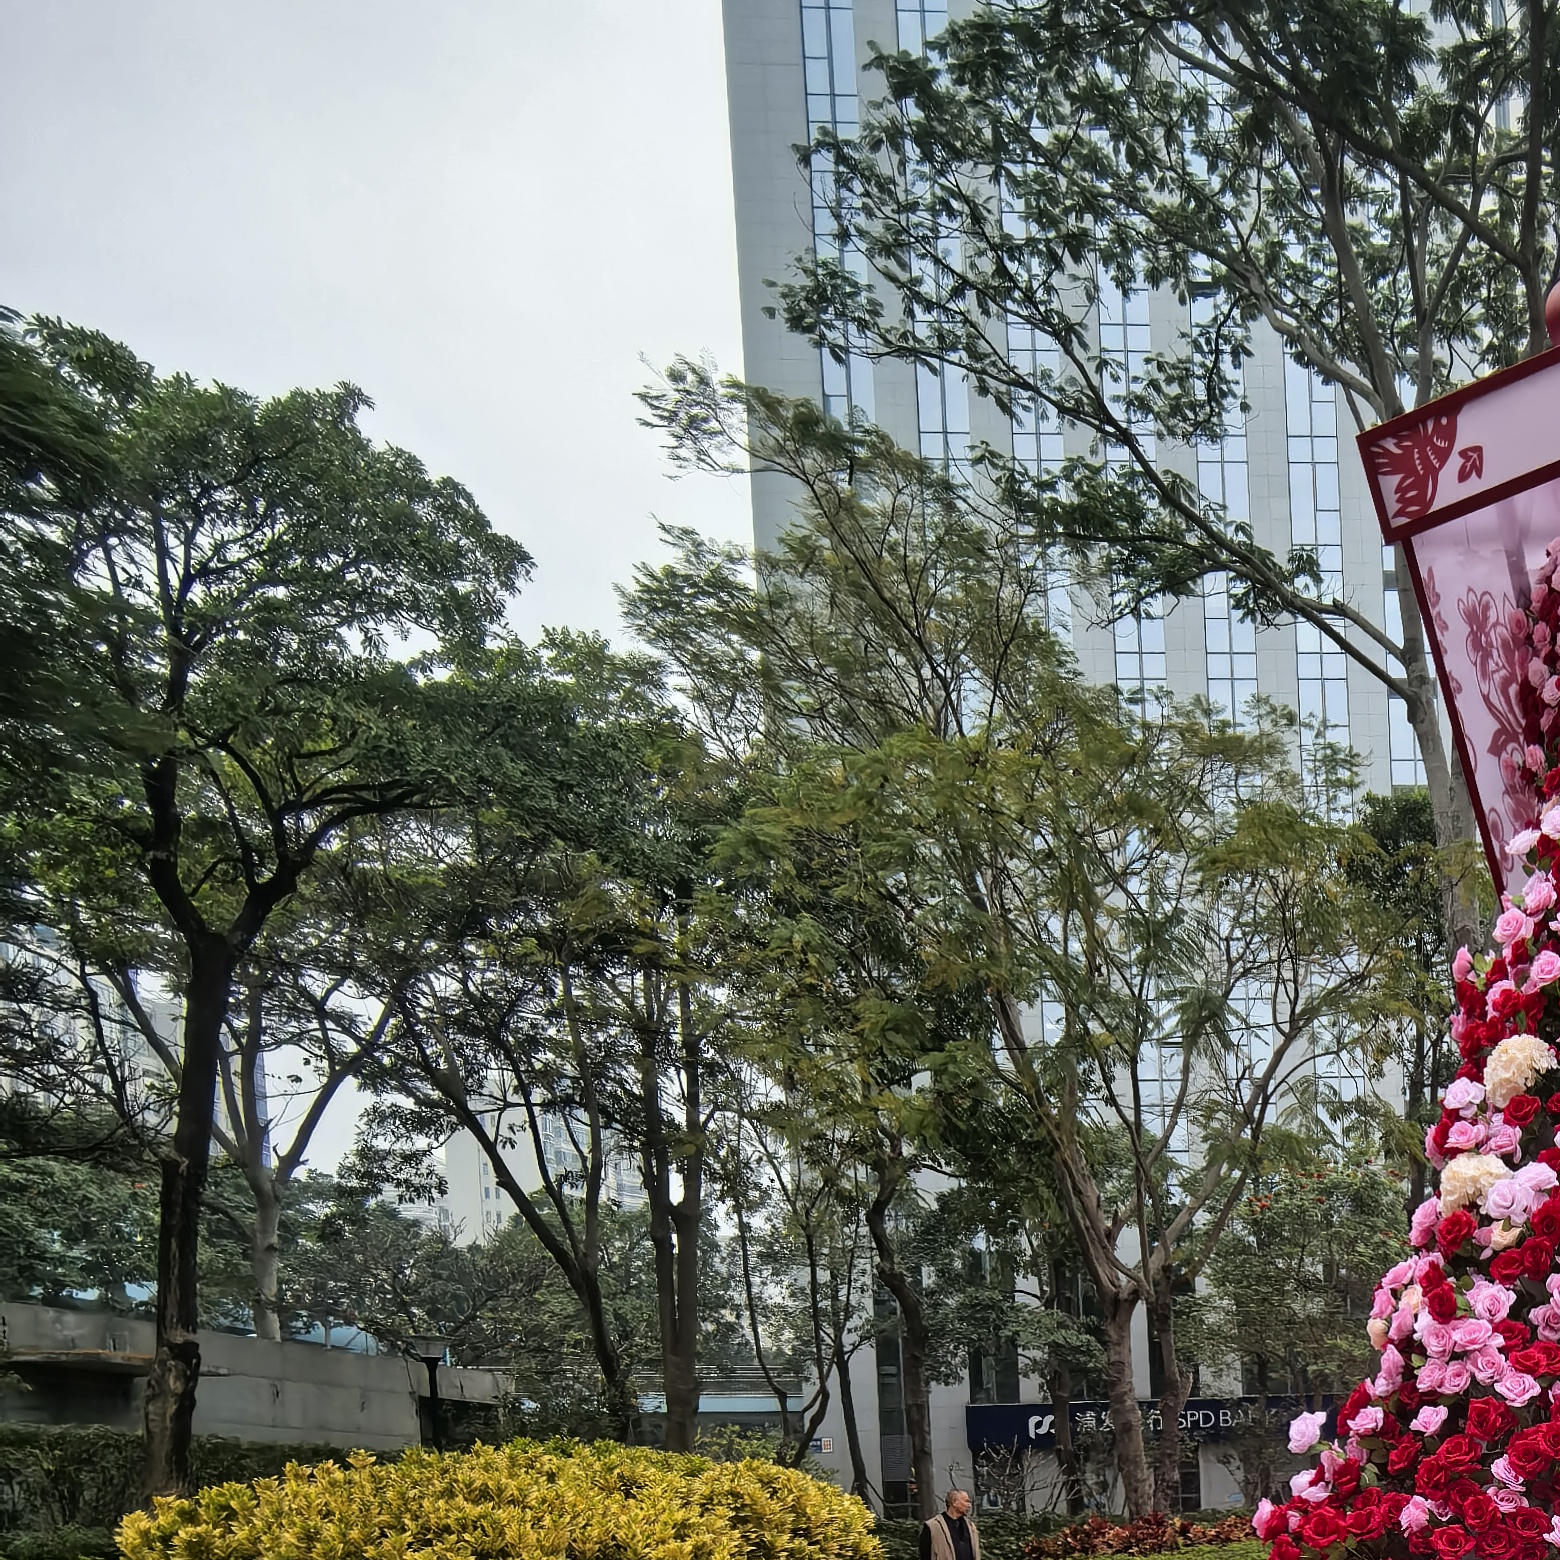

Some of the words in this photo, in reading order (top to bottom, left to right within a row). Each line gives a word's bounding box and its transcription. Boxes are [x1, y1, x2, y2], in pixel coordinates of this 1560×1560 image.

[1074, 1409, 1163, 1432] 浦发行
[1177, 1409, 1215, 1429] SPD
